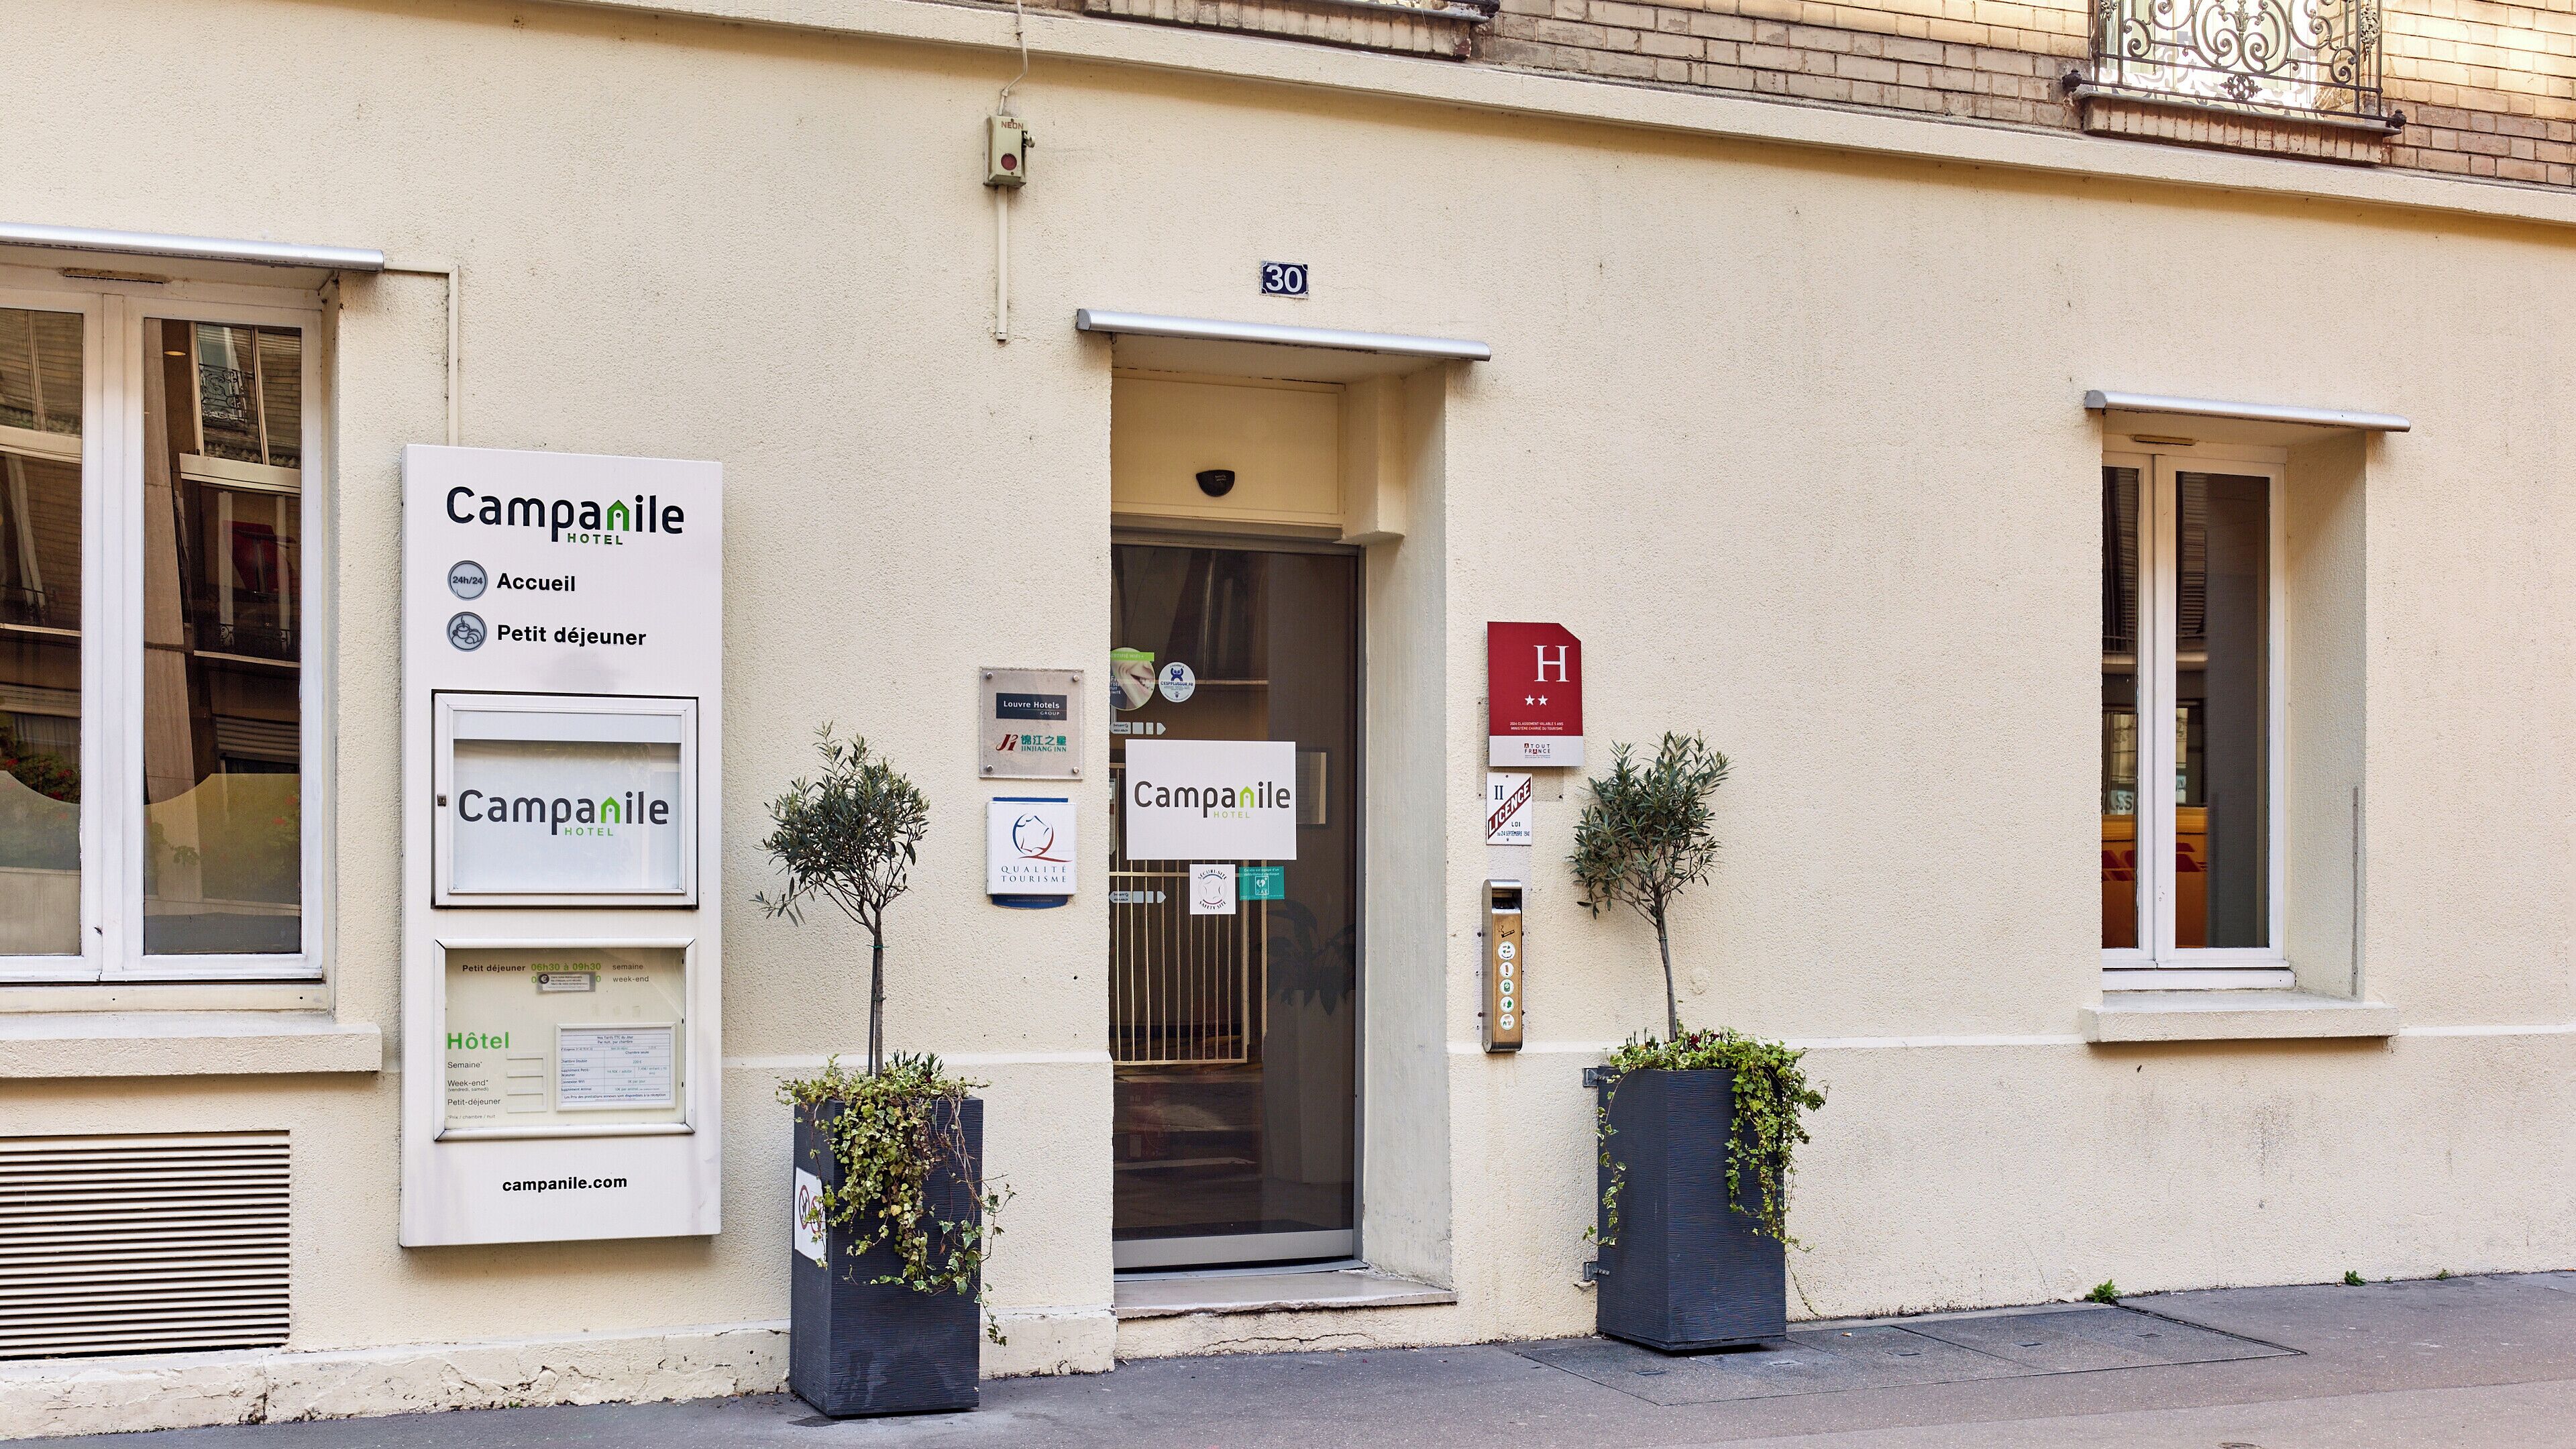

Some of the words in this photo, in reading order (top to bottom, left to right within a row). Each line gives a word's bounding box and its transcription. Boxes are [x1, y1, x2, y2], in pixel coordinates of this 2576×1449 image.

[1001, 121, 1024, 129] NEON
[1265, 265, 1303, 292] 30
[446, 486, 685, 542] Campanile
[567, 533, 623, 545] HOTEL
[452, 575, 483, 585] 24h/24
[496, 572, 576, 592] Accueil
[497, 625, 547, 642] Petit
[554, 627, 647, 647] déjeuner
[1534, 645, 1570, 682] H
[1033, 701, 1060, 709] Hotels
[1134, 780, 1291, 818] Campanile
[458, 789, 669, 835] Campanile
[1489, 781, 1530, 836] LICENCE
[564, 827, 614, 837] HOTEL
[1001, 865, 1066, 874] QUALITÉ
[486, 964, 526, 973] déjeuner
[572, 963, 601, 971] 09h30
[447, 1032, 509, 1049] Hôtel
[502, 1177, 627, 1193] campanile.com
